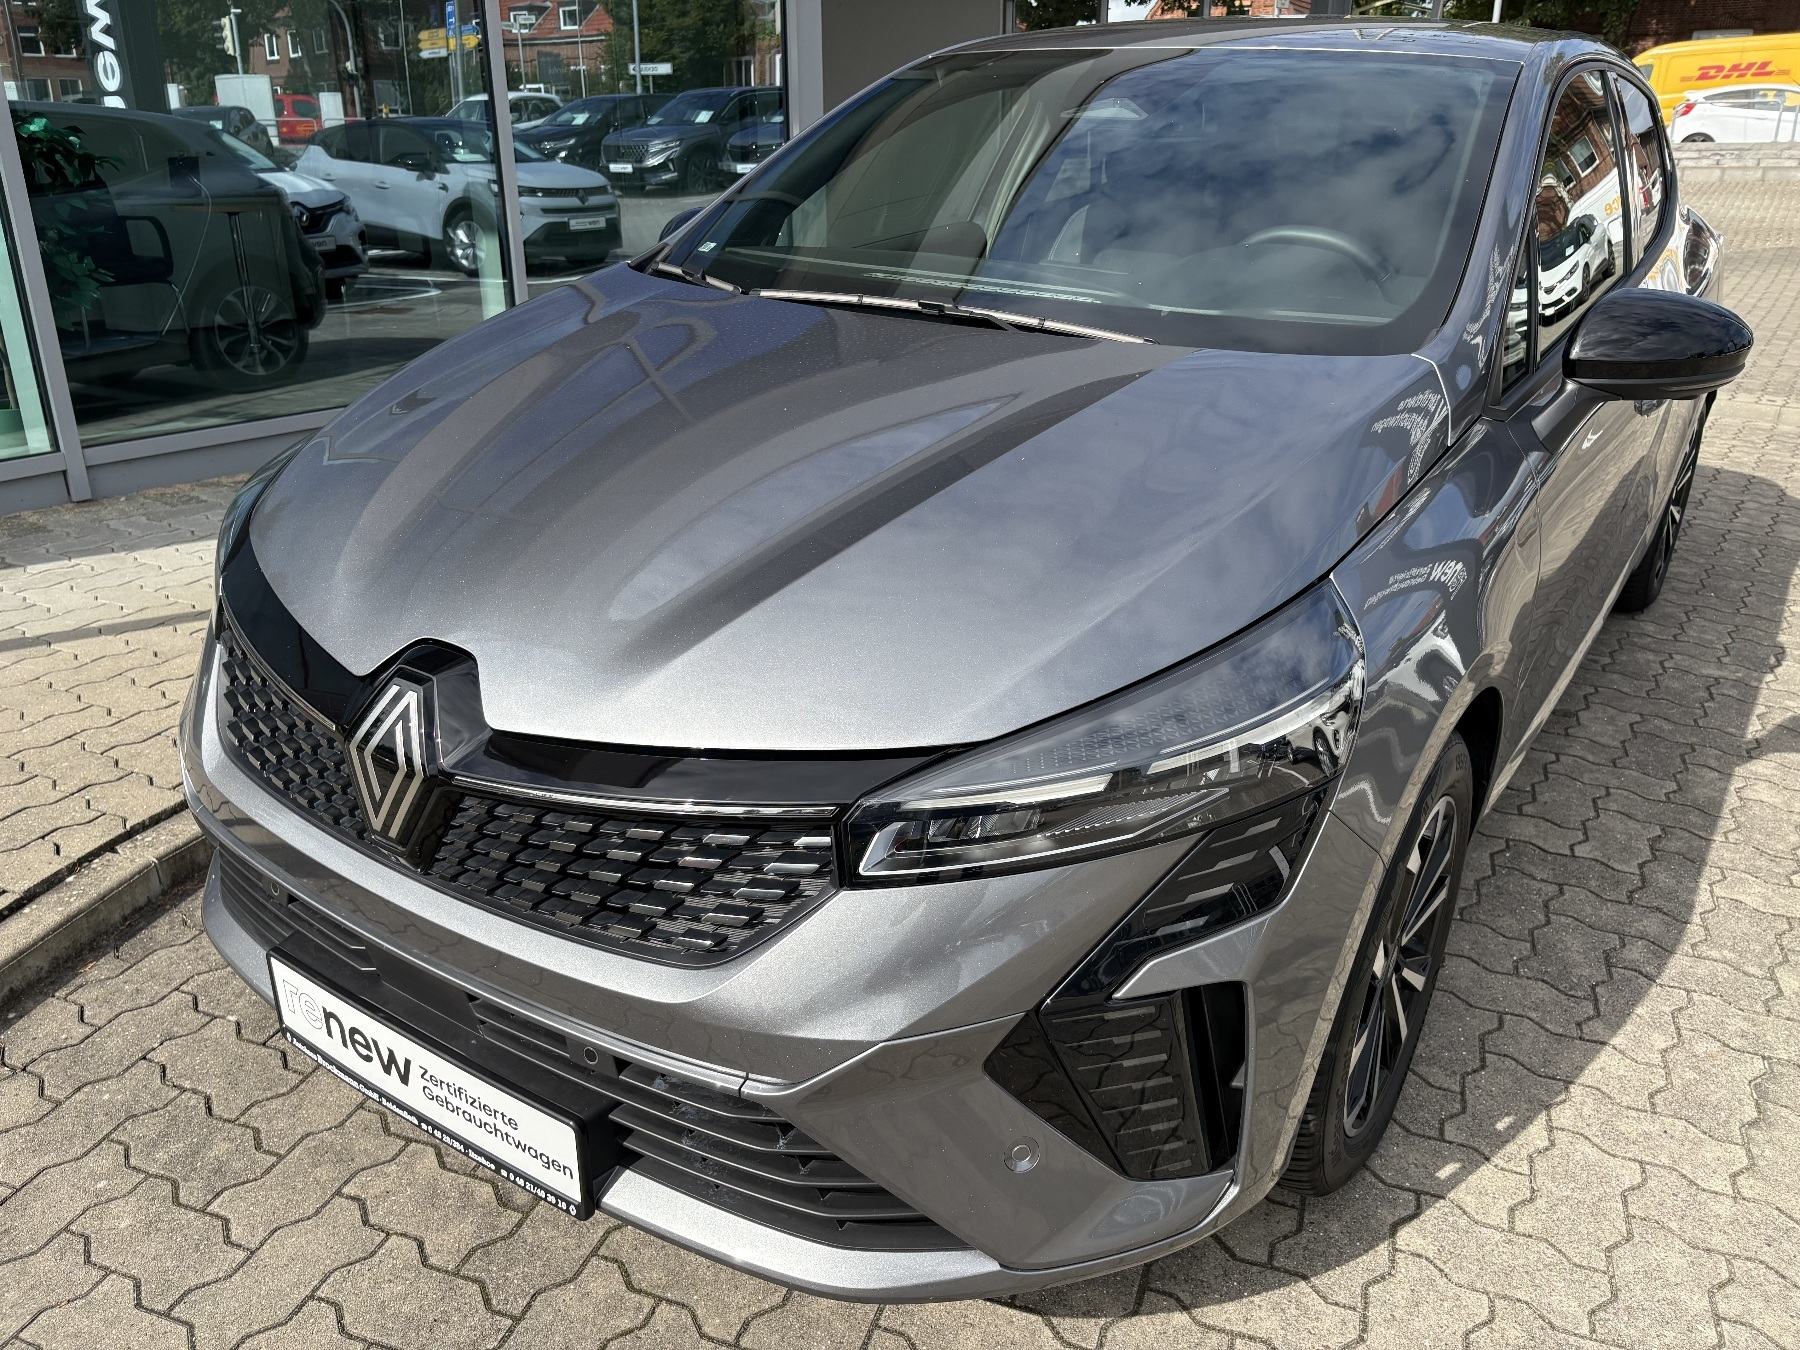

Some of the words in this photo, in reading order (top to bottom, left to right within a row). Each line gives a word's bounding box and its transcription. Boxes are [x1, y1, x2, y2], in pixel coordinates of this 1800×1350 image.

[1695, 60, 1776, 81] DHL
[418, 1064, 519, 1131] Zertifizierte
[421, 1085, 575, 1180] Gebrauchtwagen
